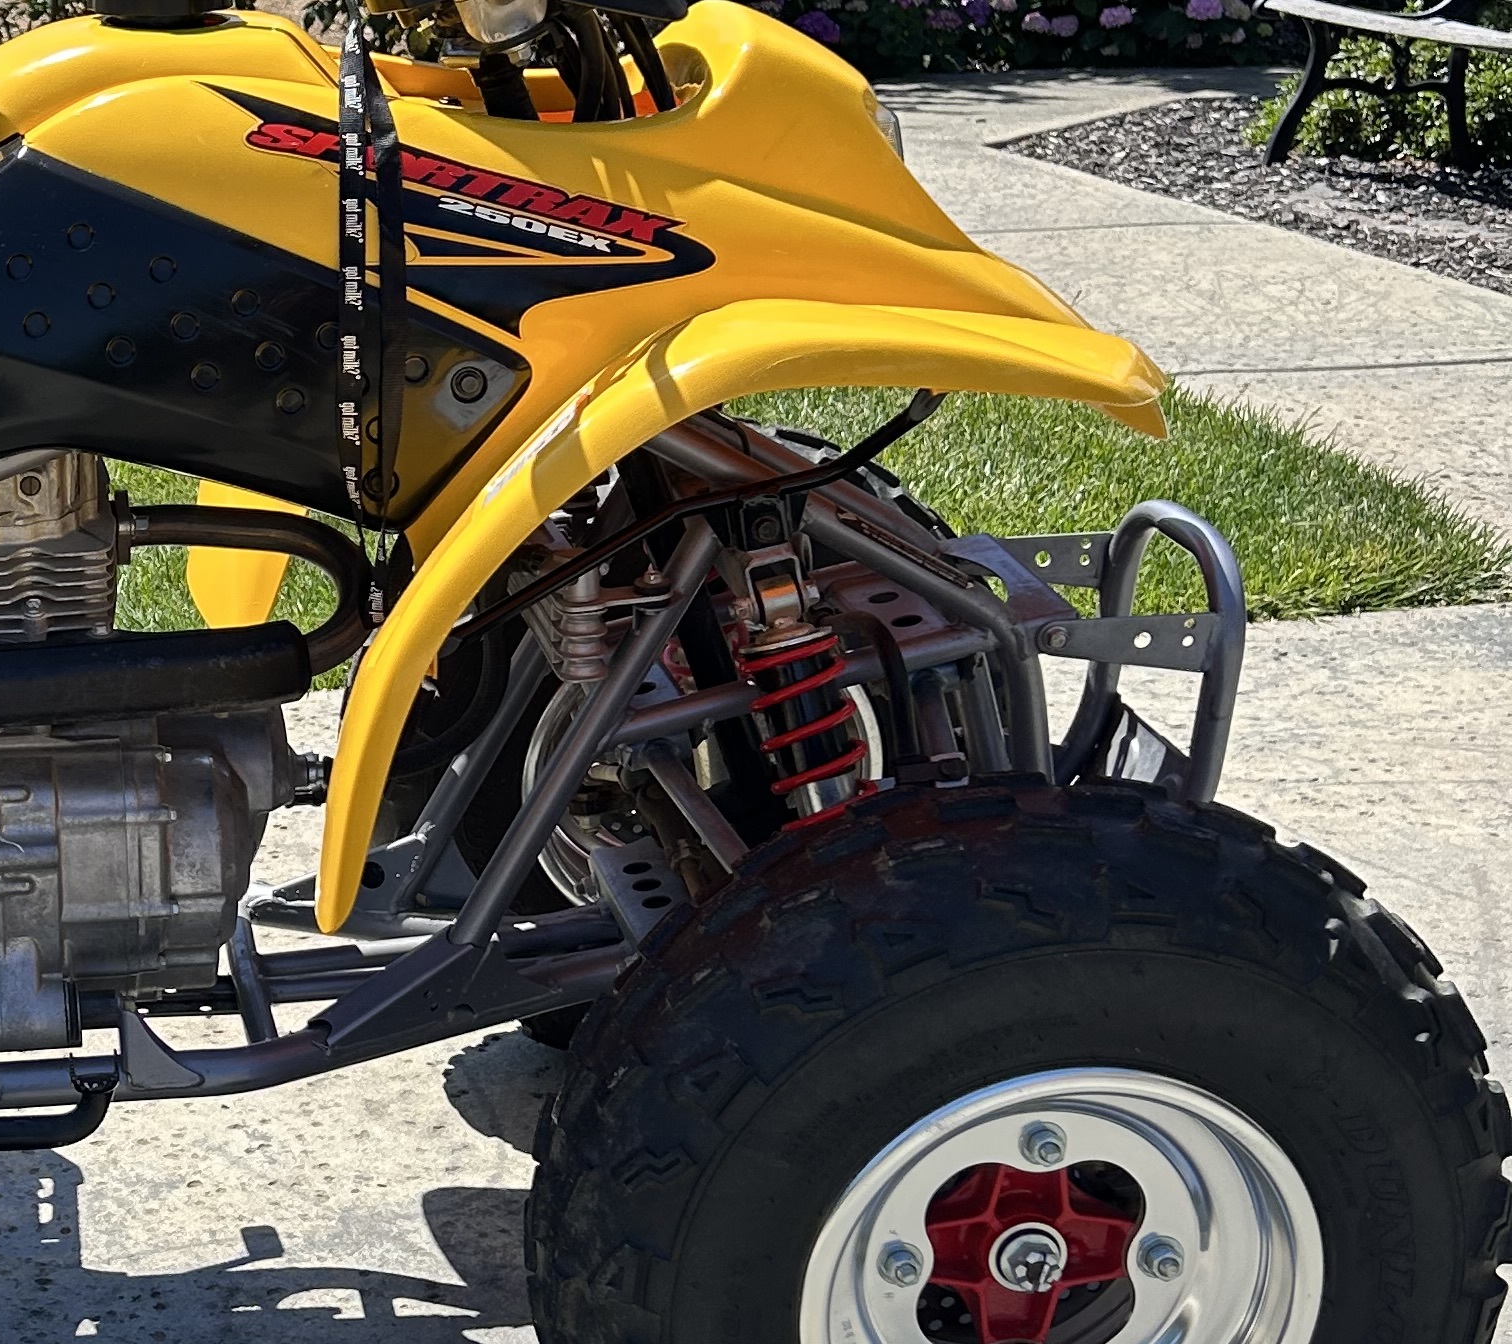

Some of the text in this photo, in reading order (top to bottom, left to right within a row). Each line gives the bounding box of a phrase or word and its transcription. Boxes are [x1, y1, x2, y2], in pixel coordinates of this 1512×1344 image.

[341, 132, 361, 146] got
[248, 123, 672, 243] SPRTRAX
[341, 198, 362, 212] got
[438, 197, 611, 253] 250EX
[341, 266, 362, 280] got
[340, 335, 360, 349] got
[338, 402, 358, 416] got
